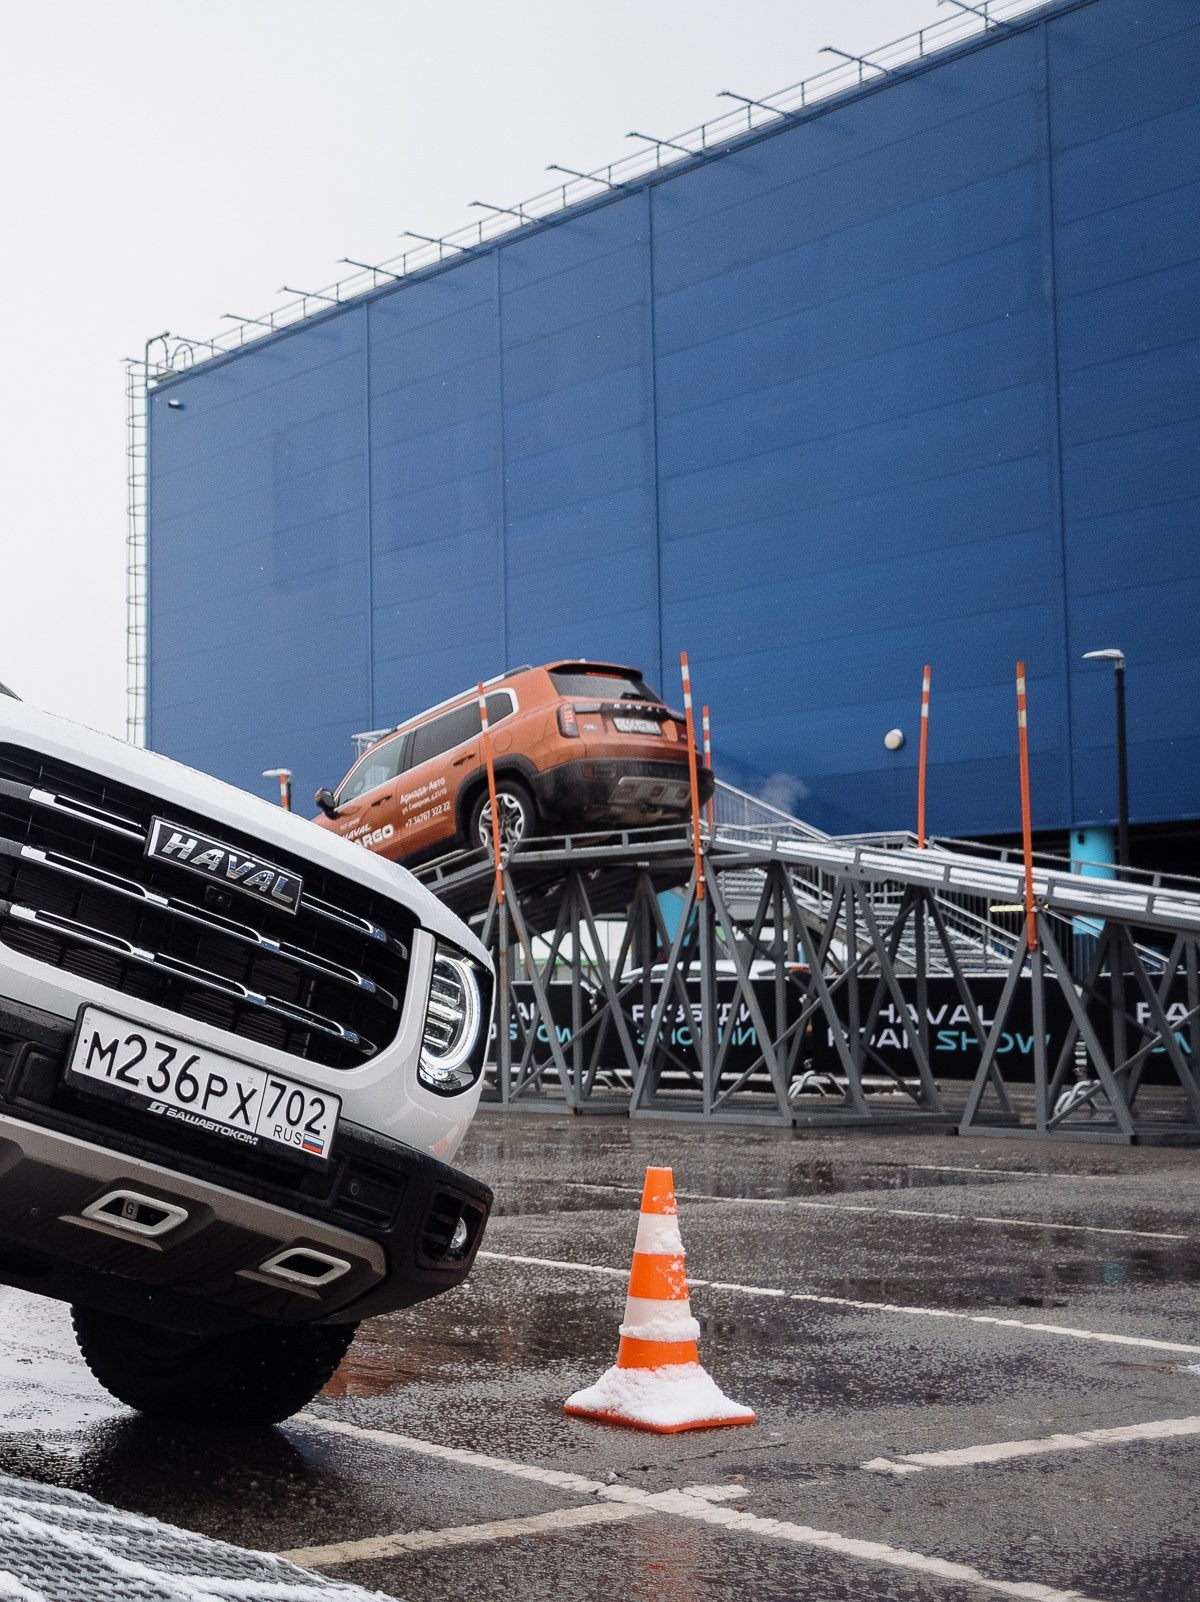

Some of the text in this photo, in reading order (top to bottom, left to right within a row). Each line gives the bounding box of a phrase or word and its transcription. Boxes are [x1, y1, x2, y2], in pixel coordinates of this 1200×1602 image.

[354, 823, 395, 848] ARGO
[161, 832, 294, 904] HAVAL
[165, 1107, 259, 1146] БАШАВТОКОМ
[266, 1080, 327, 1136] 702
[272, 1123, 303, 1146] RUS
